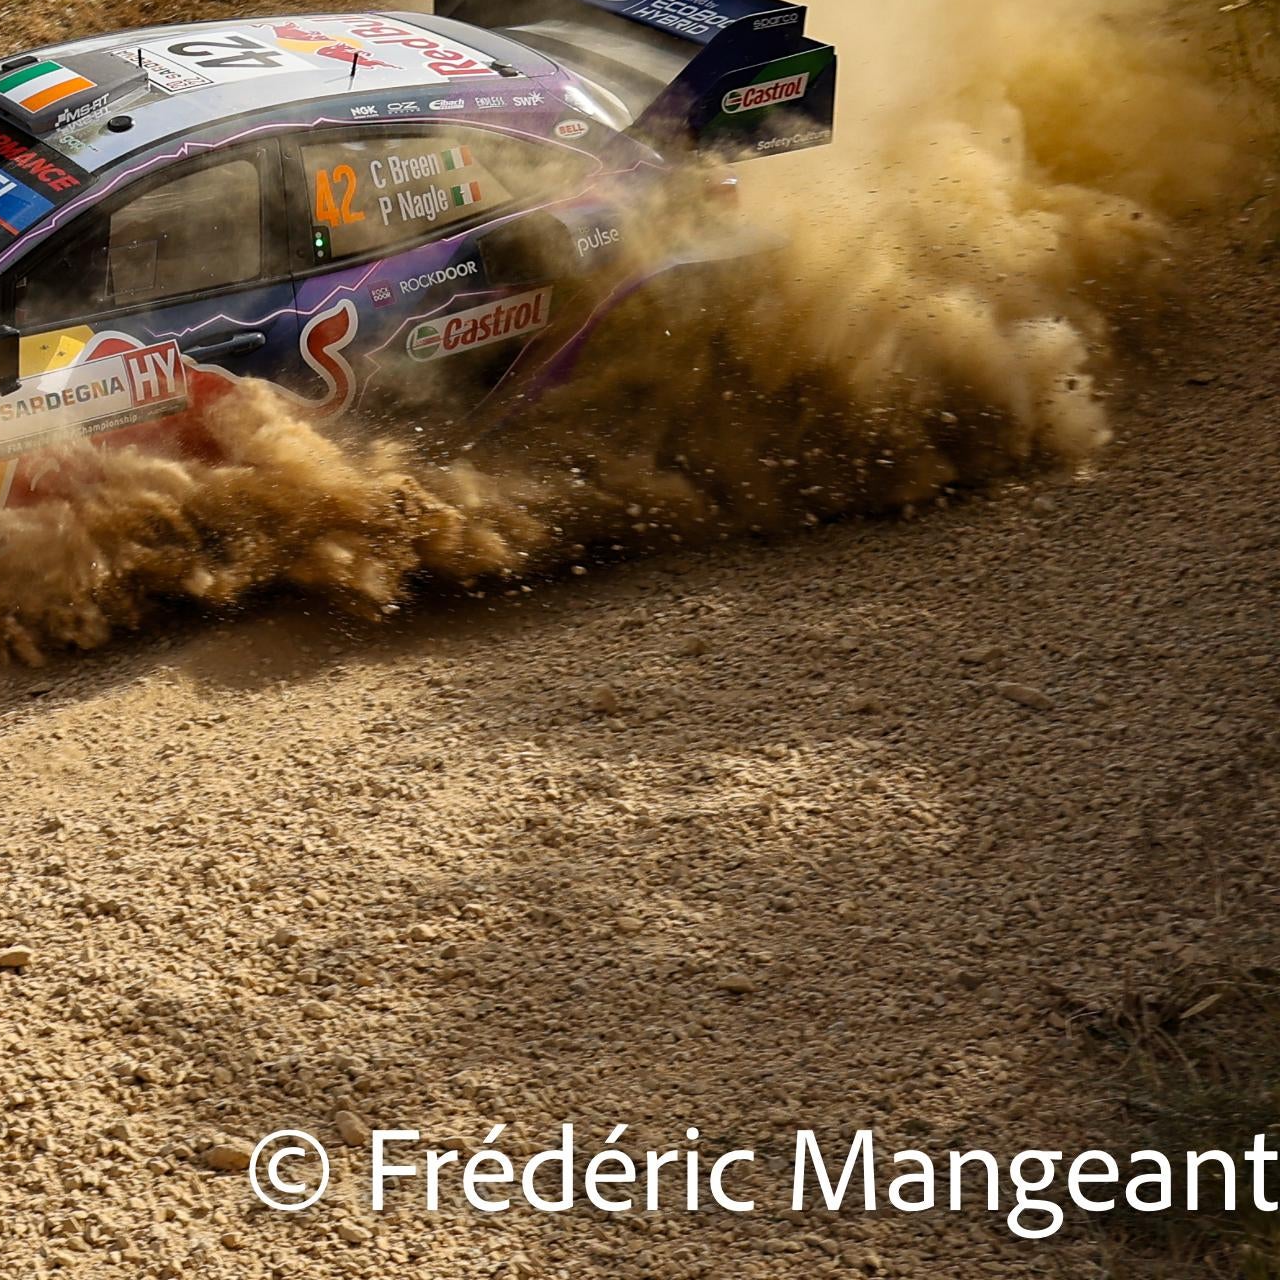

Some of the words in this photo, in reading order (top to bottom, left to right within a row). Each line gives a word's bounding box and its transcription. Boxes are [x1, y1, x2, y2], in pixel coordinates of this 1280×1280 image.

[631, 6, 710, 35] HYBRID
[167, 34, 285, 68] 42
[742, 77, 803, 108] Castrol
[350, 105, 378, 117] NGK
[559, 123, 585, 136] BELL
[370, 159, 387, 189] C
[387, 151, 441, 186] Breen
[314, 164, 366, 228] 42
[378, 196, 393, 226] P
[397, 184, 449, 222] Nagle
[577, 227, 620, 257] pulse
[399, 260, 478, 295] ROCKDOOR
[442, 293, 542, 352] Castrol
[128, 347, 177, 402] HY
[0, 376, 126, 422] SARDEGNA
[80, 414, 138, 434] hampionship
